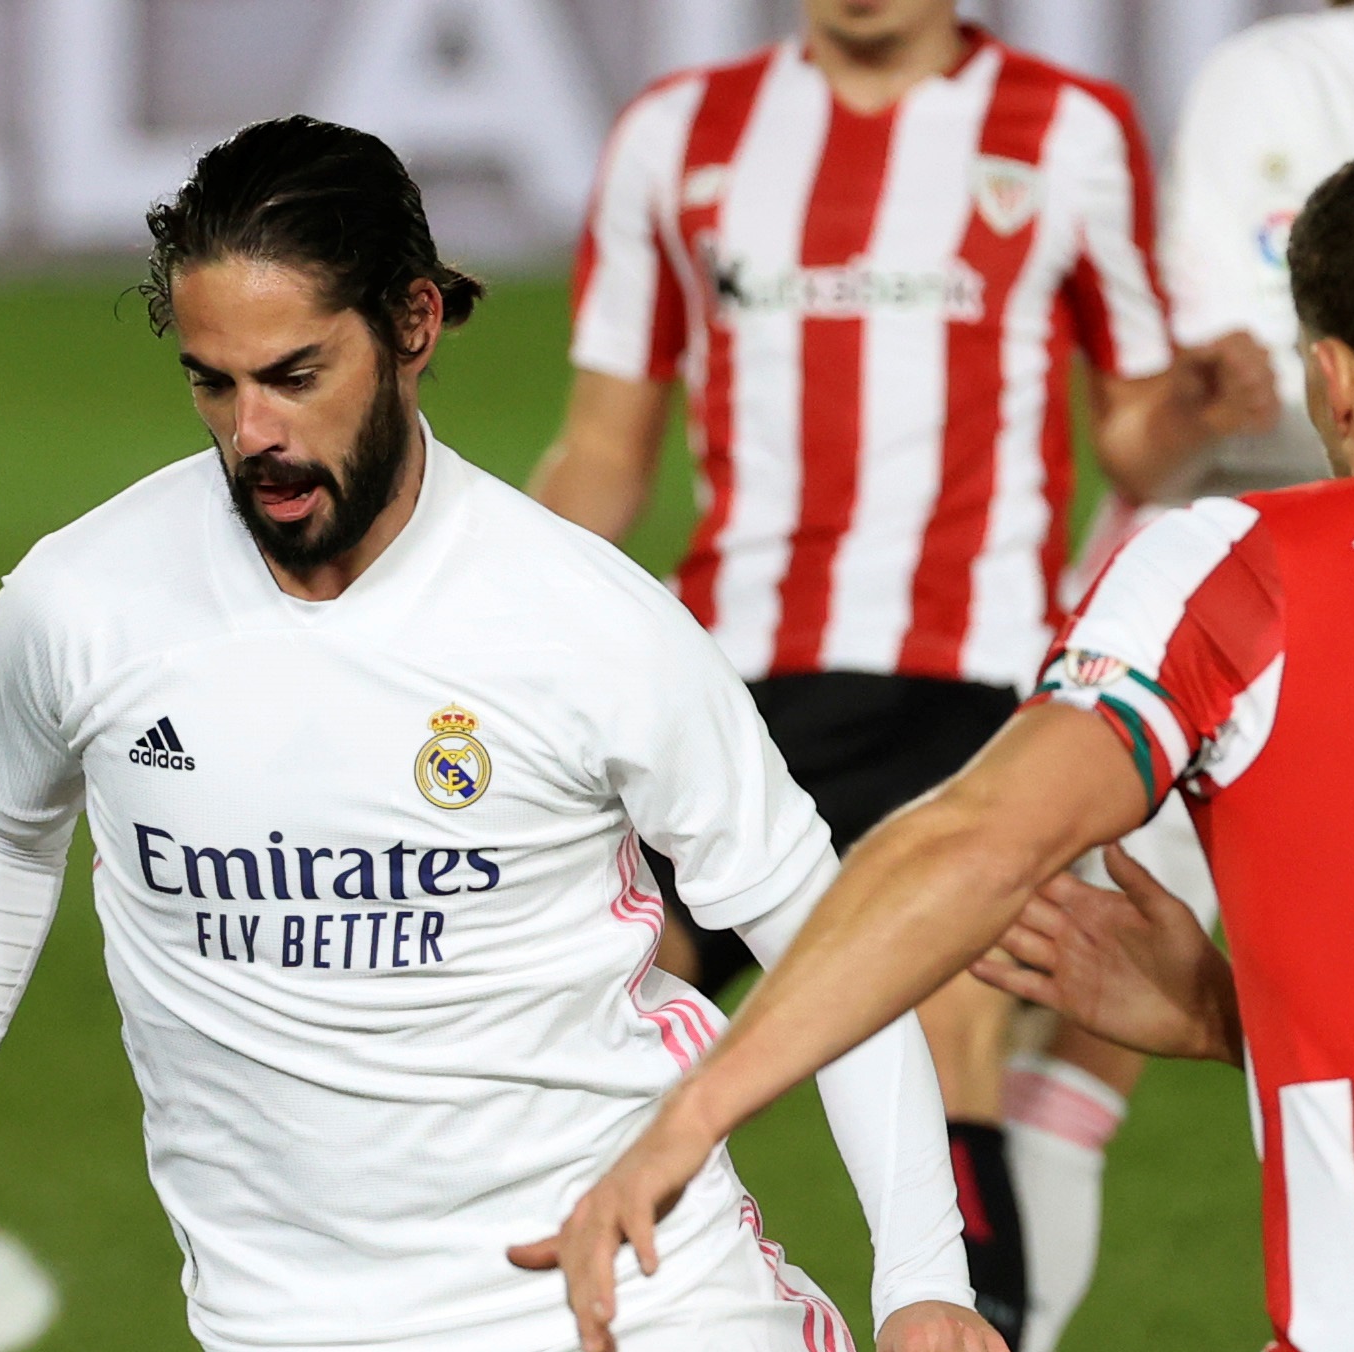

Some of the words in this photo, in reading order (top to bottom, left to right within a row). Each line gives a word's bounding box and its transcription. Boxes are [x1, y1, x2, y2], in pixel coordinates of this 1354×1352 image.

[129, 747, 195, 771] adidas
[133, 822, 501, 900] Emirates
[196, 911, 260, 963] FLY
[282, 910, 445, 970] BETTER
